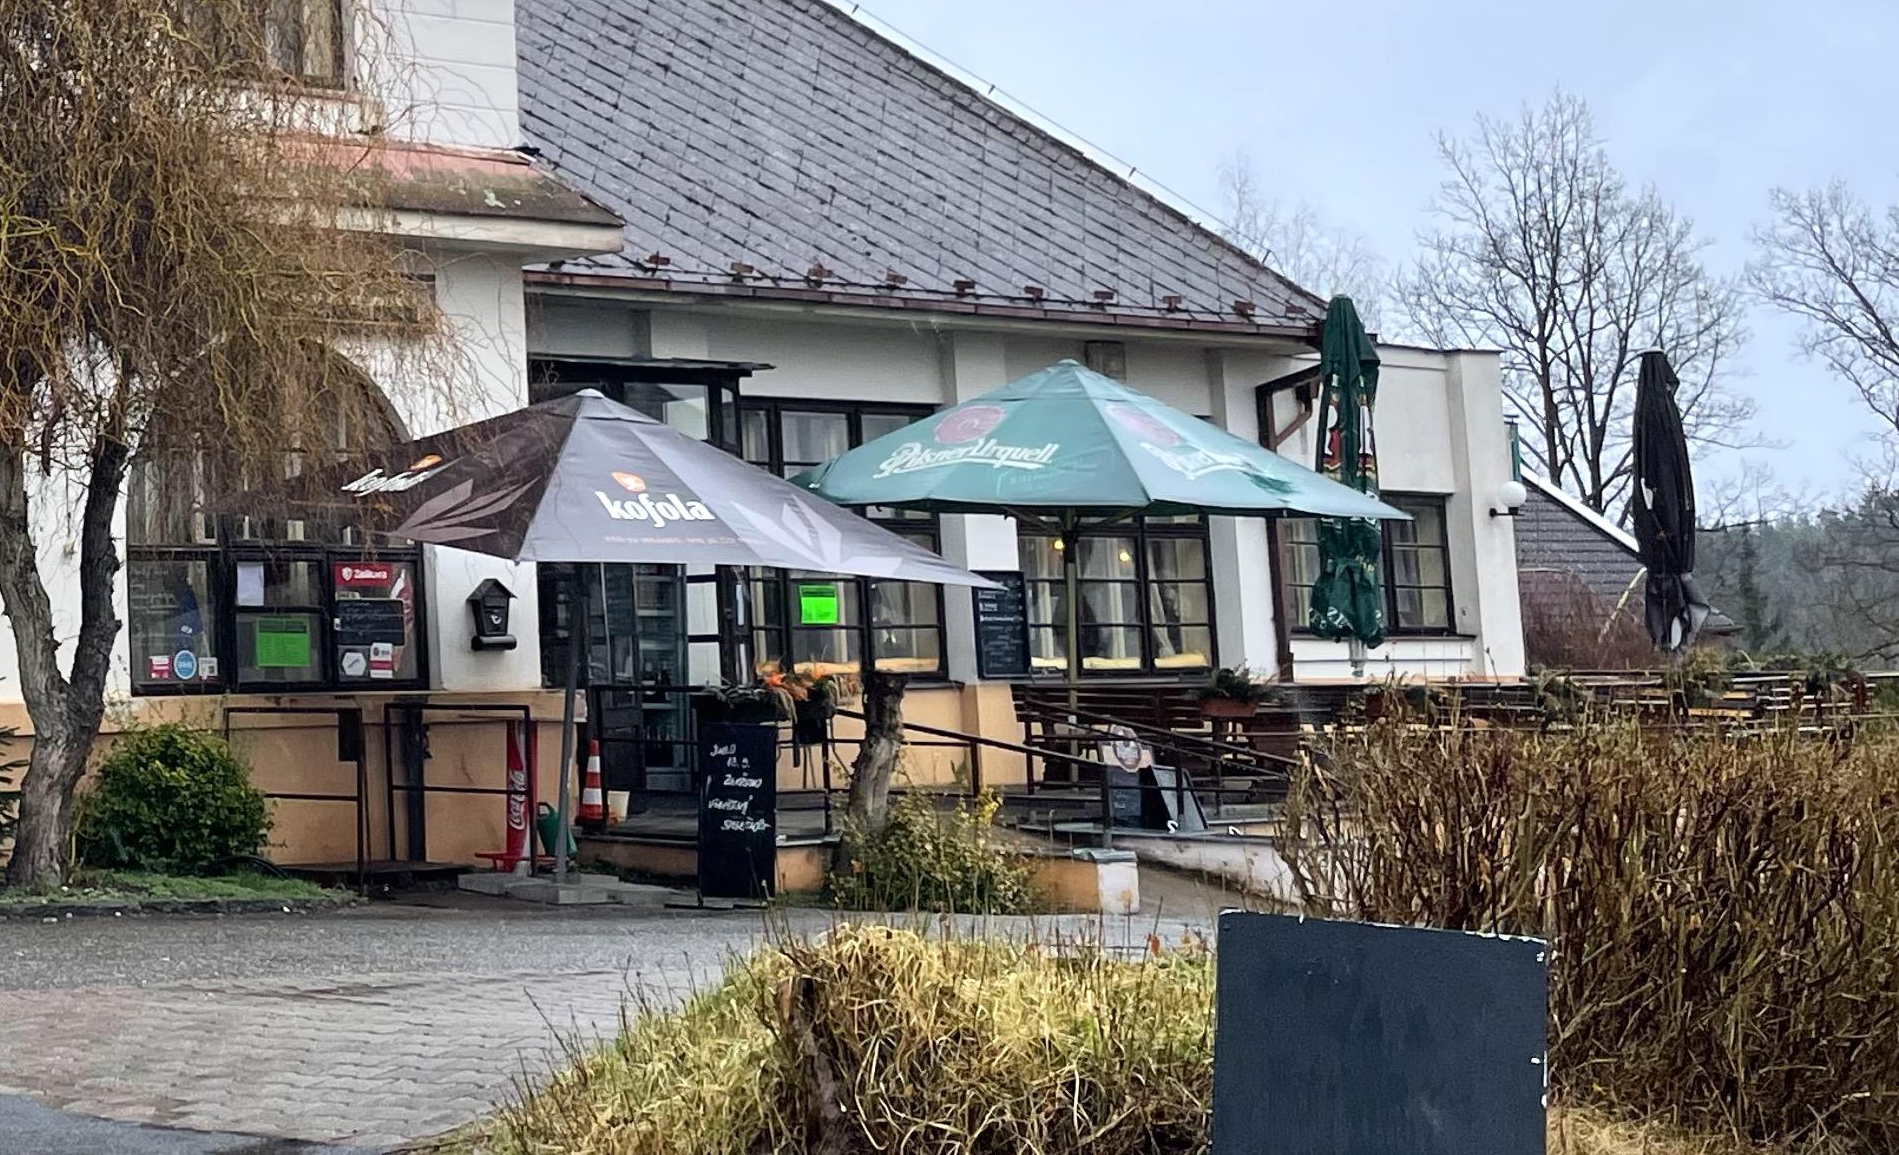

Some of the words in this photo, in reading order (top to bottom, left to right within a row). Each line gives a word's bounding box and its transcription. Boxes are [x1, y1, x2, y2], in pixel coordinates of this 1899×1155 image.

[873, 442, 977, 479] Pilsner
[974, 438, 1059, 470] Urquell
[595, 491, 715, 528] kofola
